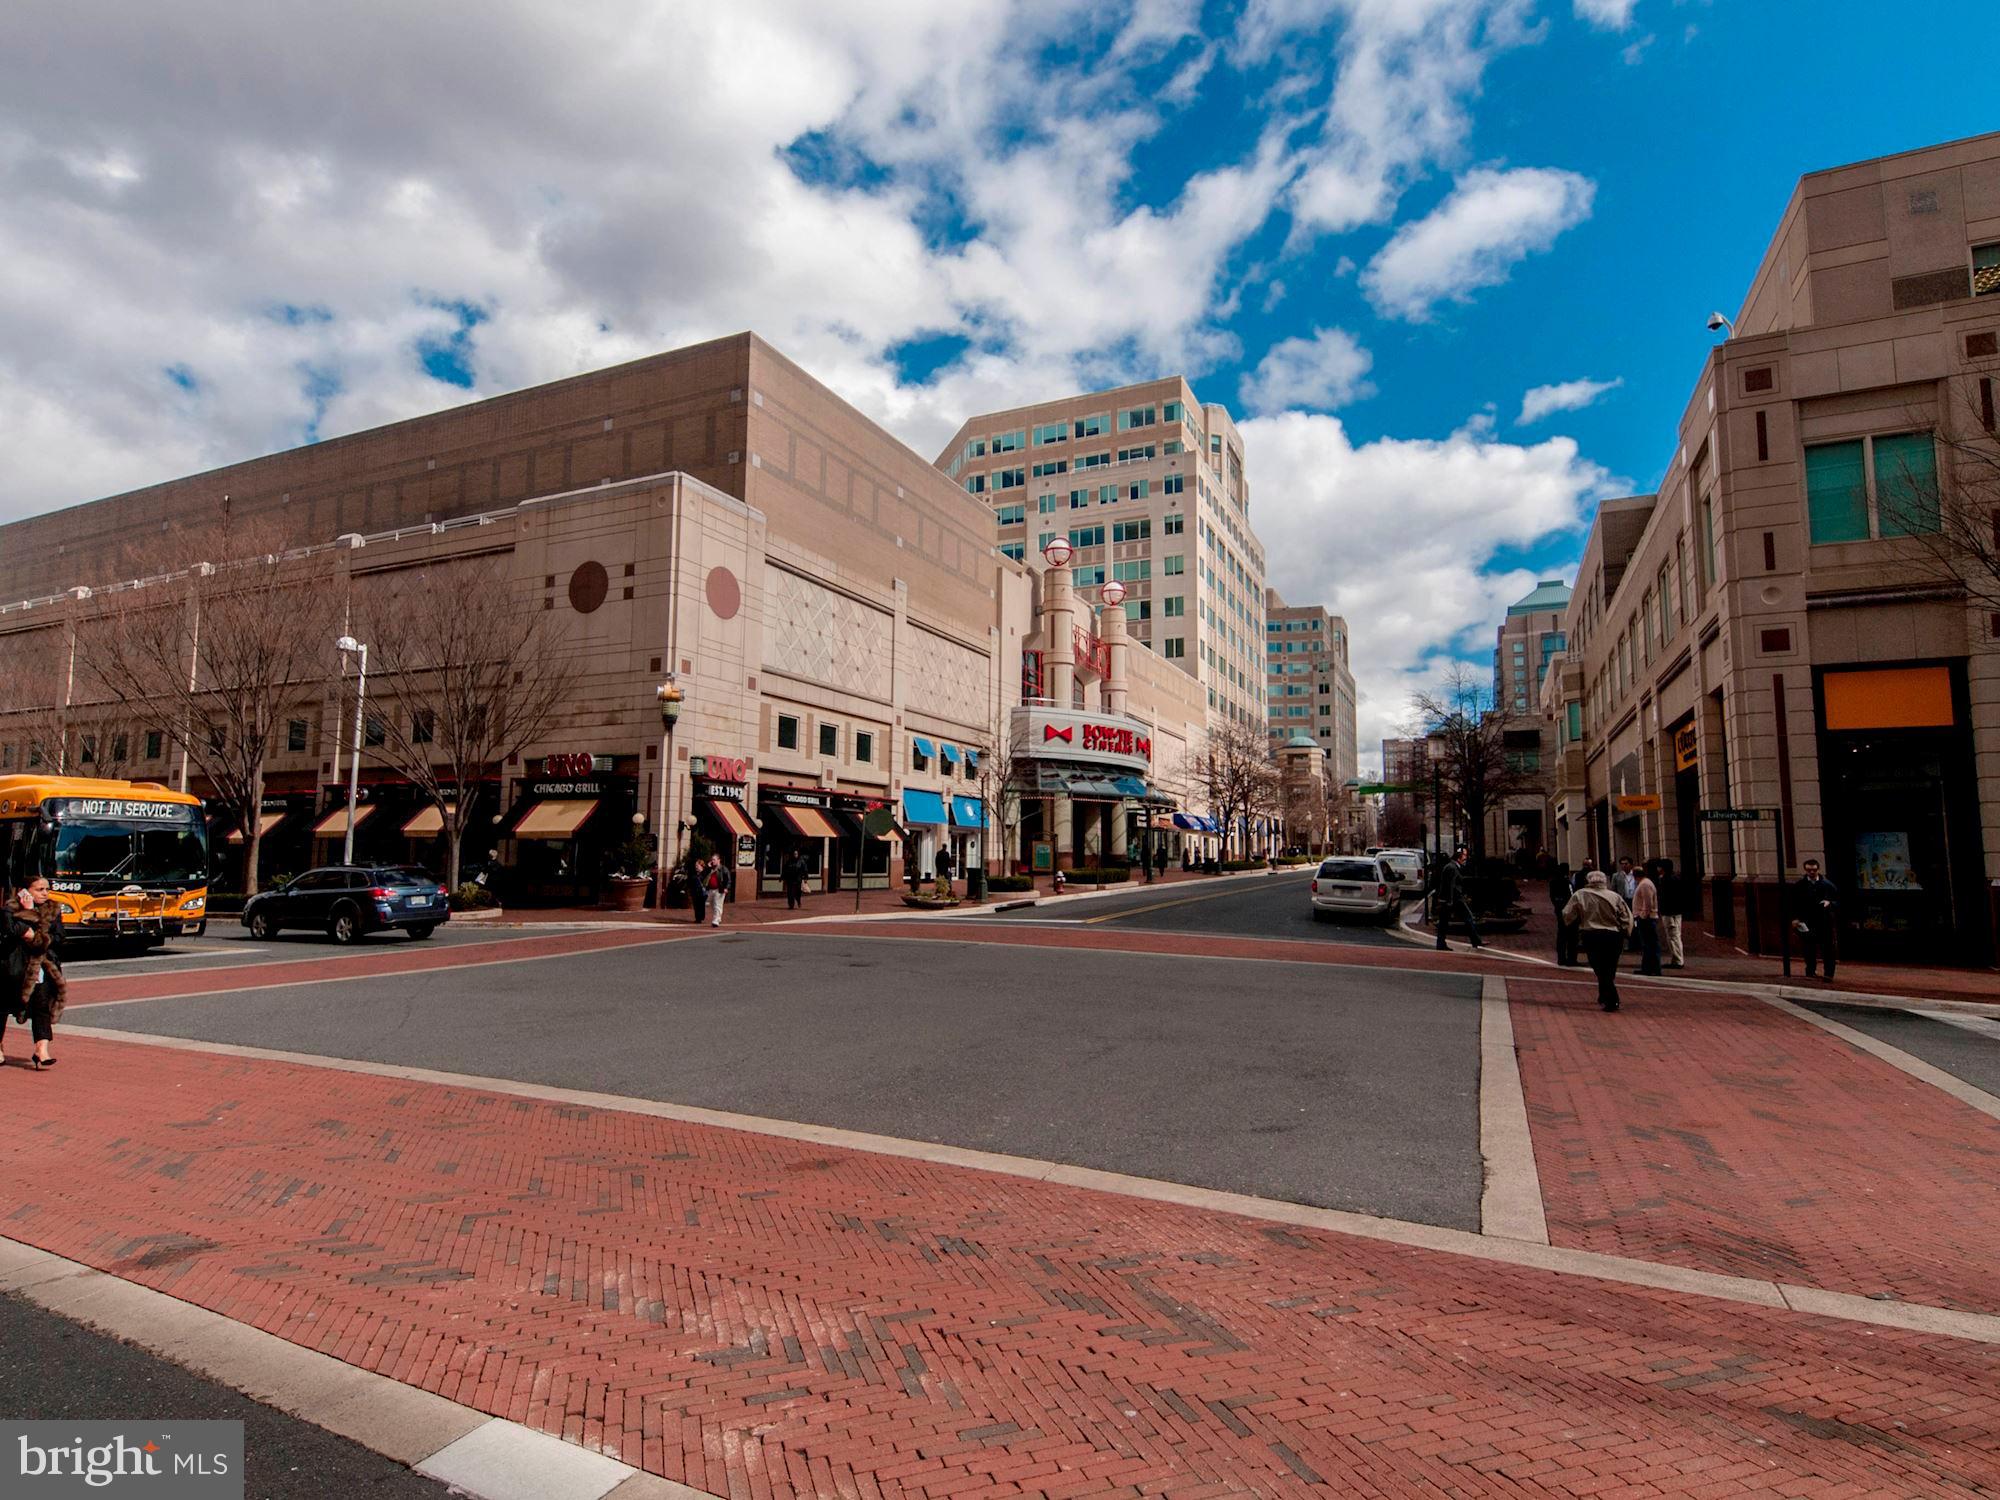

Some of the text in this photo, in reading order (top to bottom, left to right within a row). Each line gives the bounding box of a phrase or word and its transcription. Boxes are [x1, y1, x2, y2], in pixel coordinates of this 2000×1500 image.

[547, 753, 593, 777] UNO
[706, 755, 747, 782] UNO
[533, 782, 601, 794] CHICAGO GRILL
[708, 785, 725, 797] EST.
[82, 800, 173, 818] NOT IN SERVICE
[1707, 810, 1738, 820] Library
